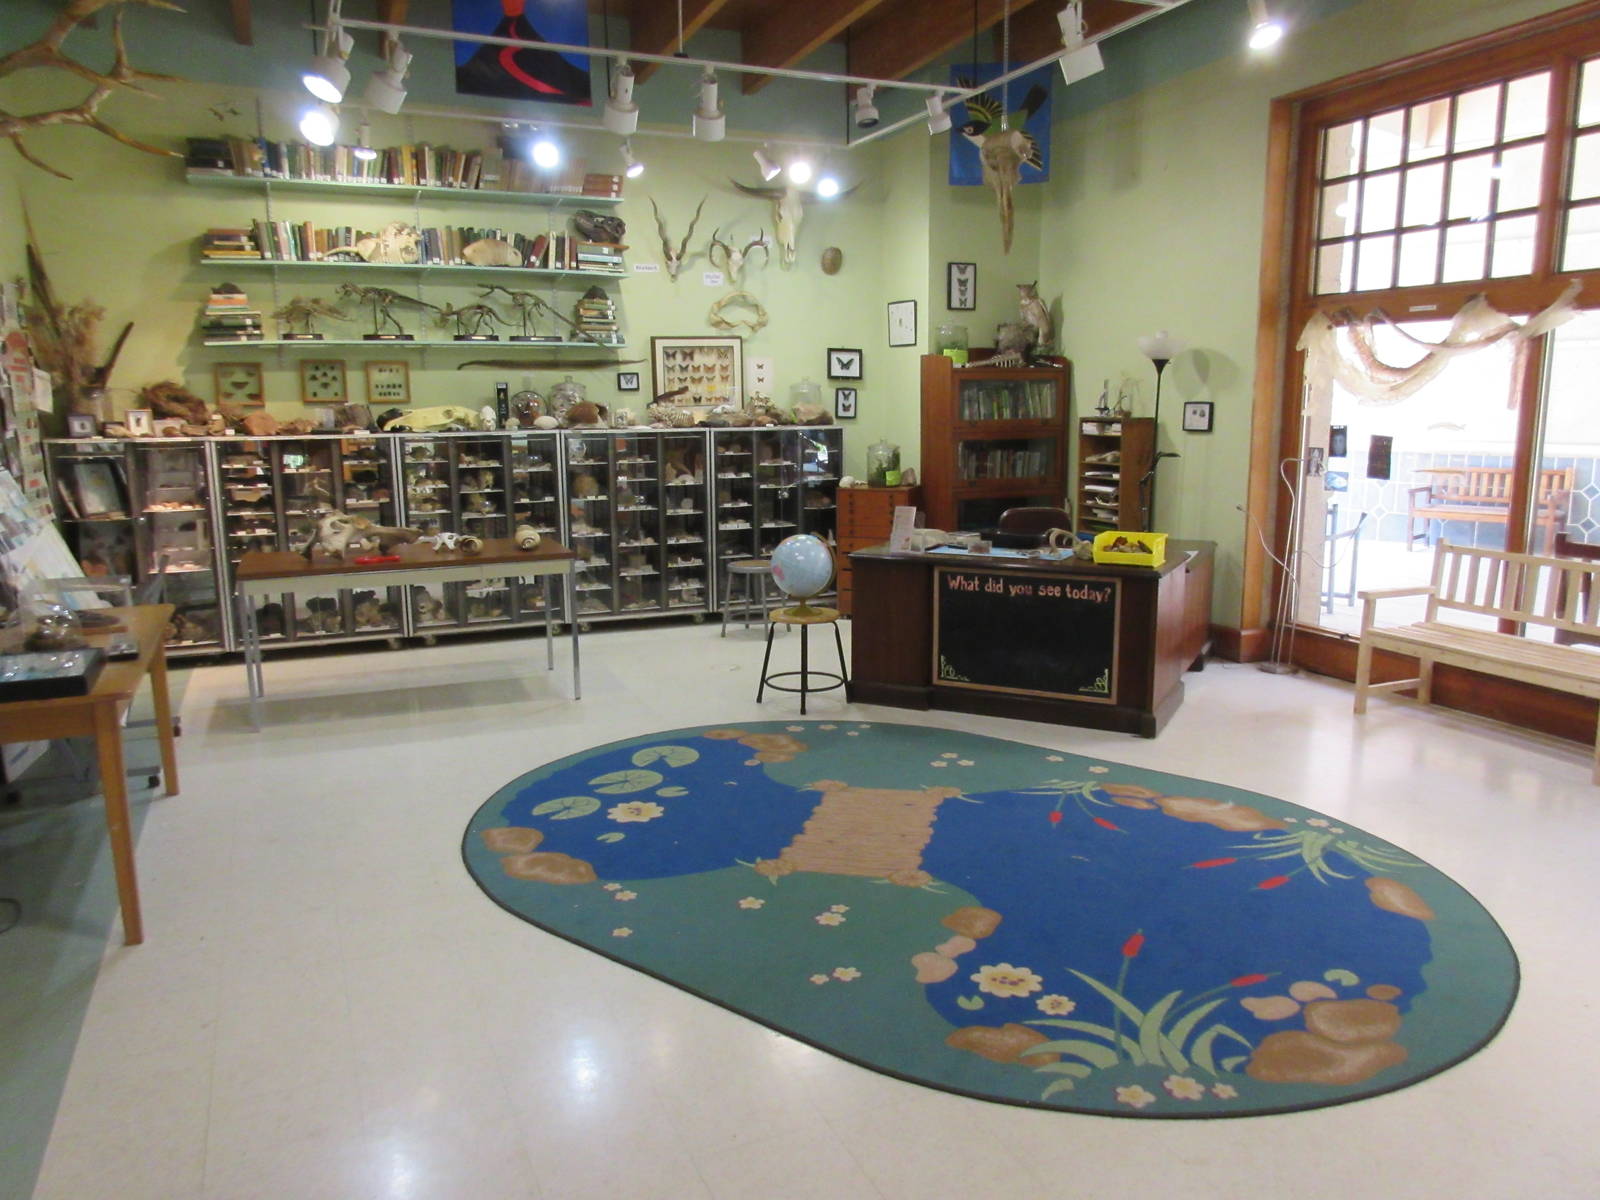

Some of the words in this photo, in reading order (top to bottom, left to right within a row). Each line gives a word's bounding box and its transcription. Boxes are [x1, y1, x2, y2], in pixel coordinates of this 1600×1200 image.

[947, 575, 980, 592] What
[984, 578, 1003, 593] did
[1008, 584, 1033, 597] you
[1038, 585, 1061, 597] see
[1065, 584, 1111, 603] today?
